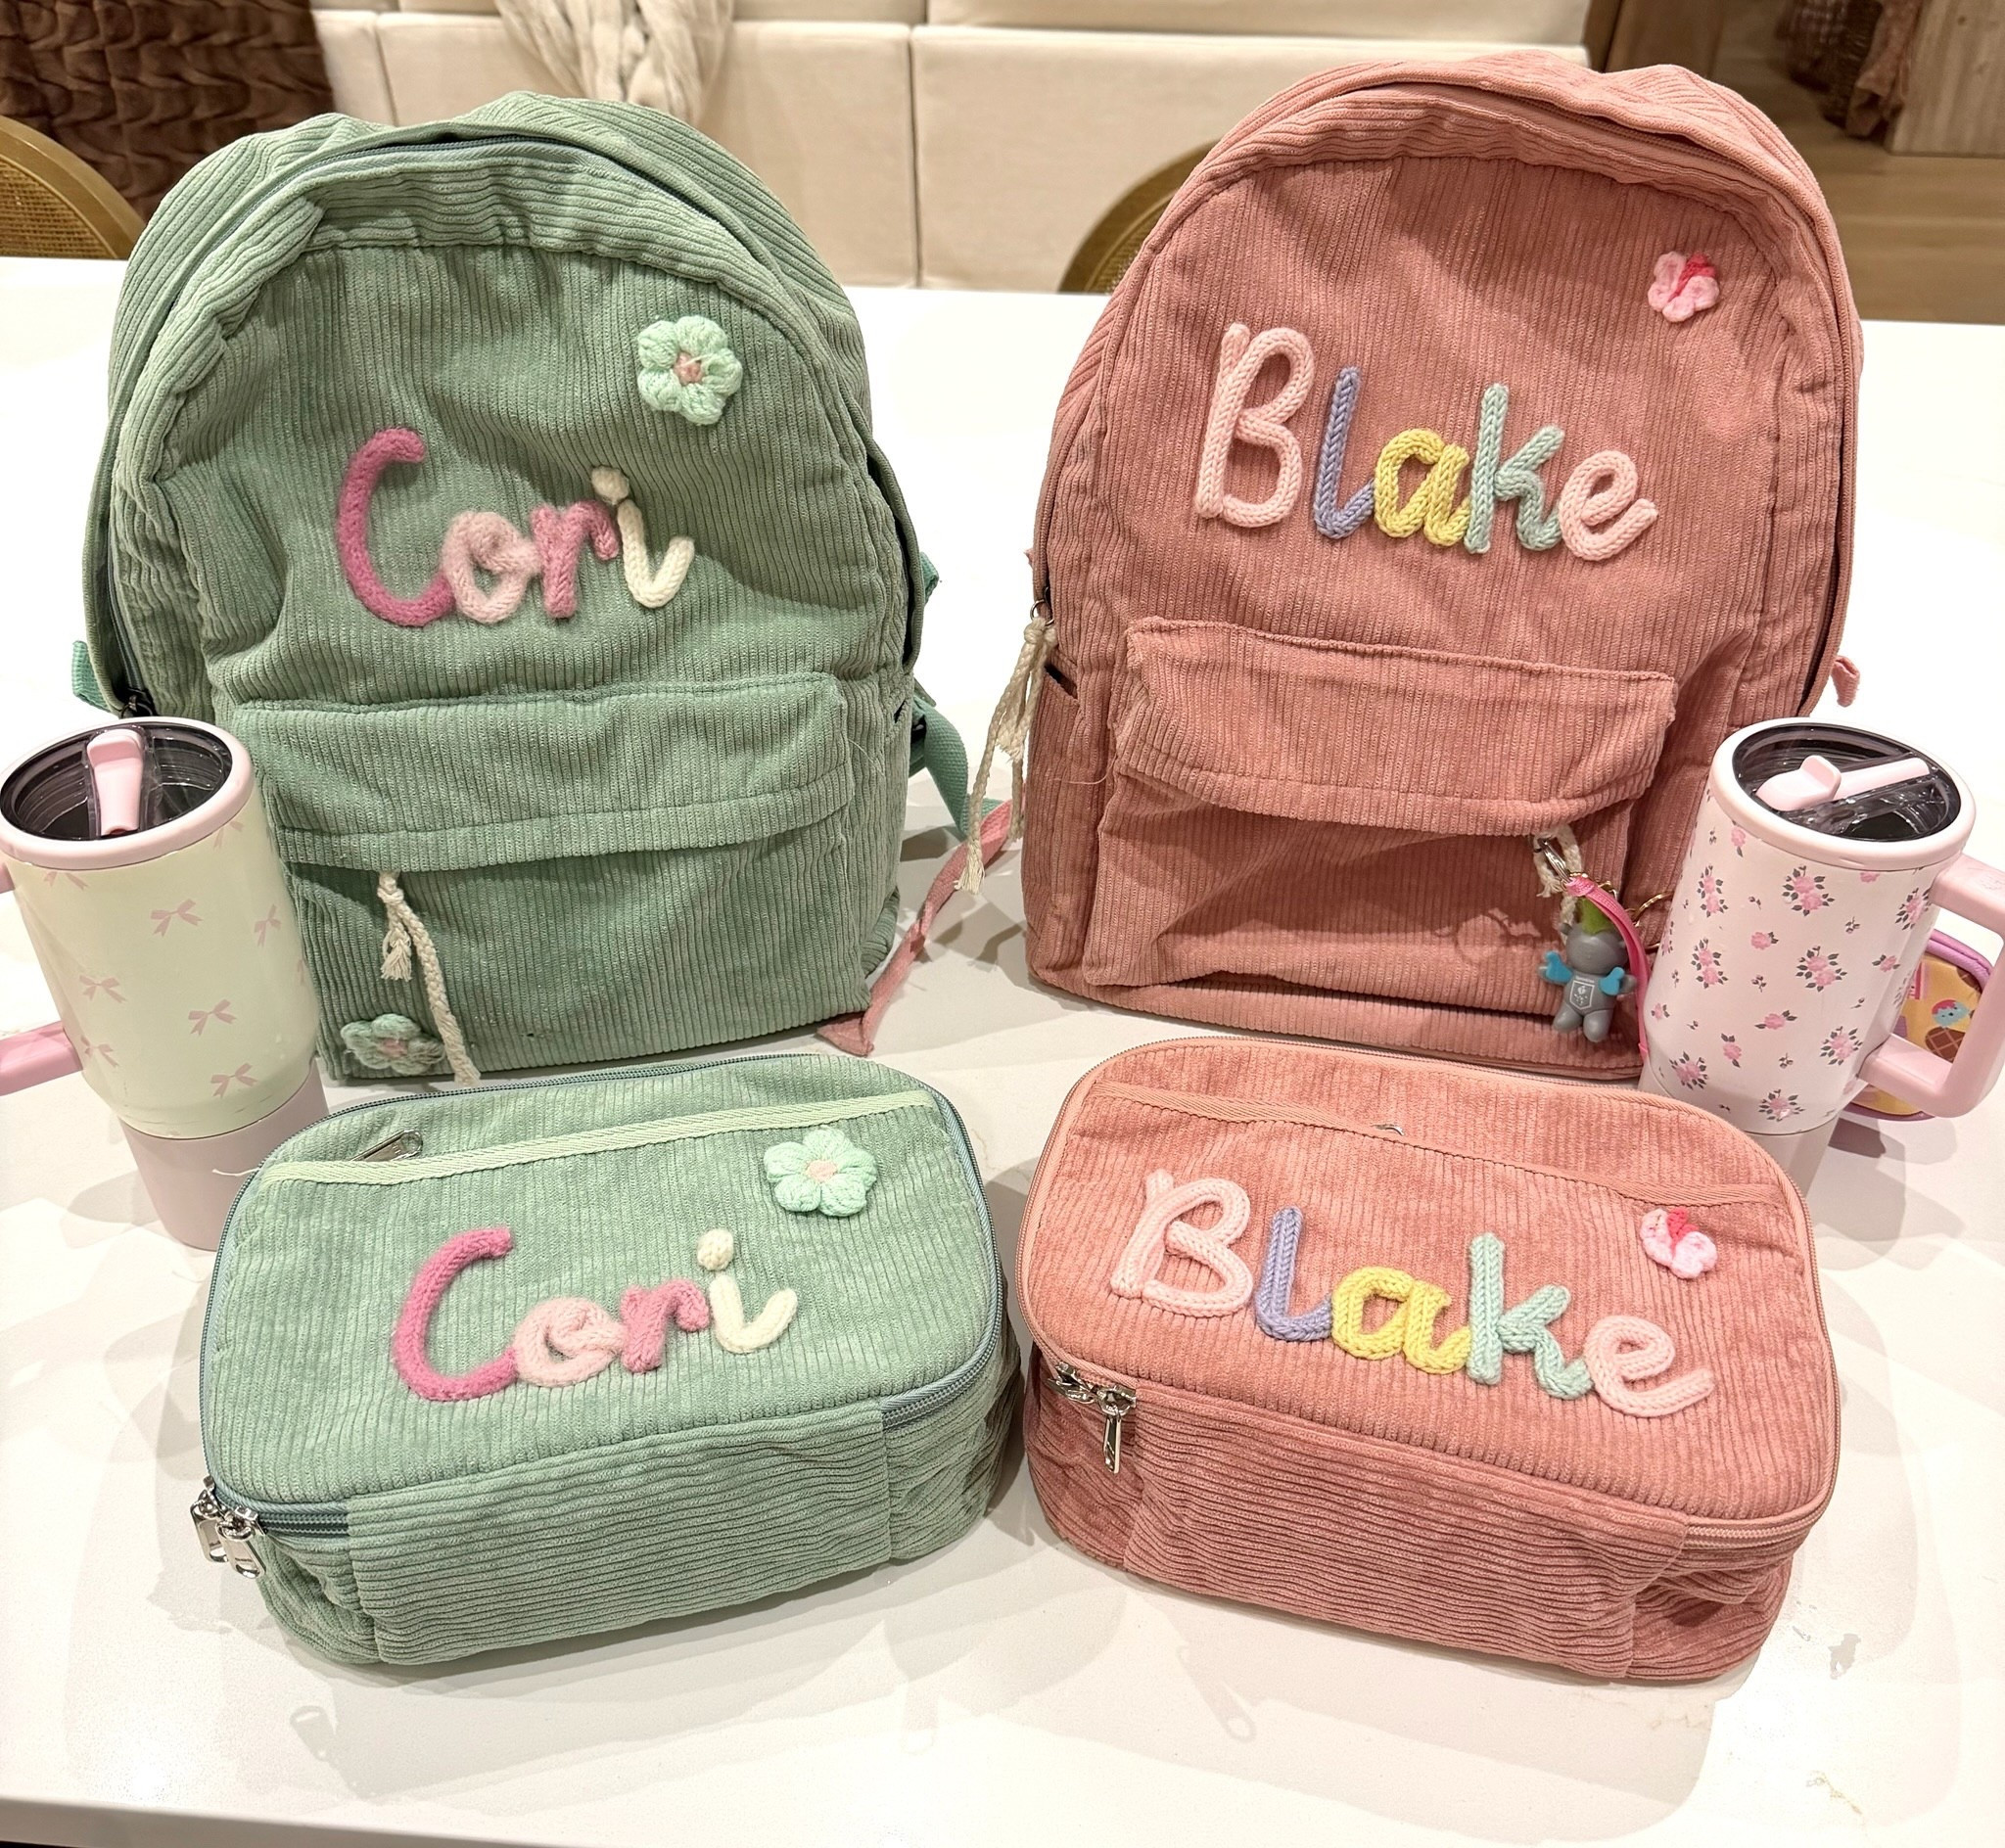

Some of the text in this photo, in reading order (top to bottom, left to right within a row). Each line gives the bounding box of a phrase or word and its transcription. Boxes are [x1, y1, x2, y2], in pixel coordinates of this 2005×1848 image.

[338, 427, 695, 626] Cori
[1194, 323, 1657, 561] Blake
[393, 1225, 798, 1402] Cori
[1110, 1169, 1716, 1417] Blake
